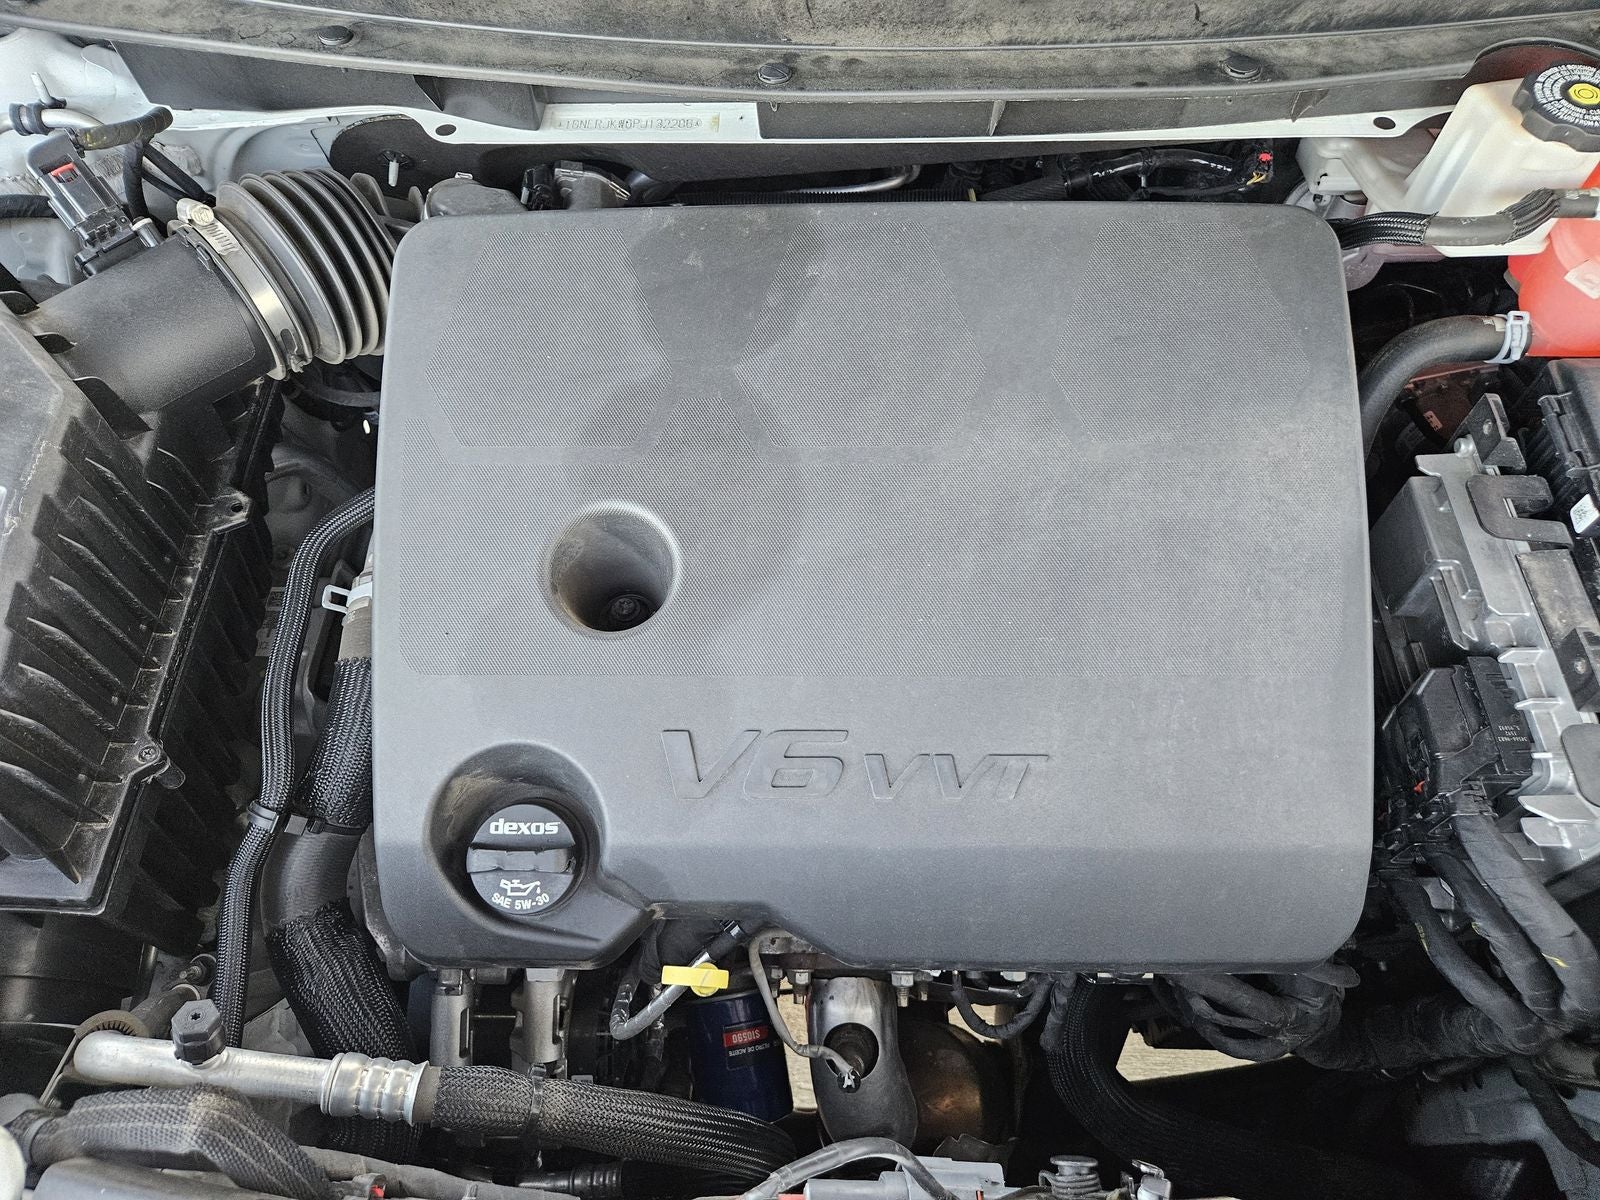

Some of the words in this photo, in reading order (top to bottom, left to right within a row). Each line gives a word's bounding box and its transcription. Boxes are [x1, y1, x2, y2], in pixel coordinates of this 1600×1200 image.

[660, 729, 849, 800] V6
[863, 752, 1050, 800] VVT
[489, 818, 560, 835] dexos
[491, 892, 512, 909] SAE
[514, 893, 550, 911] 5W-30
